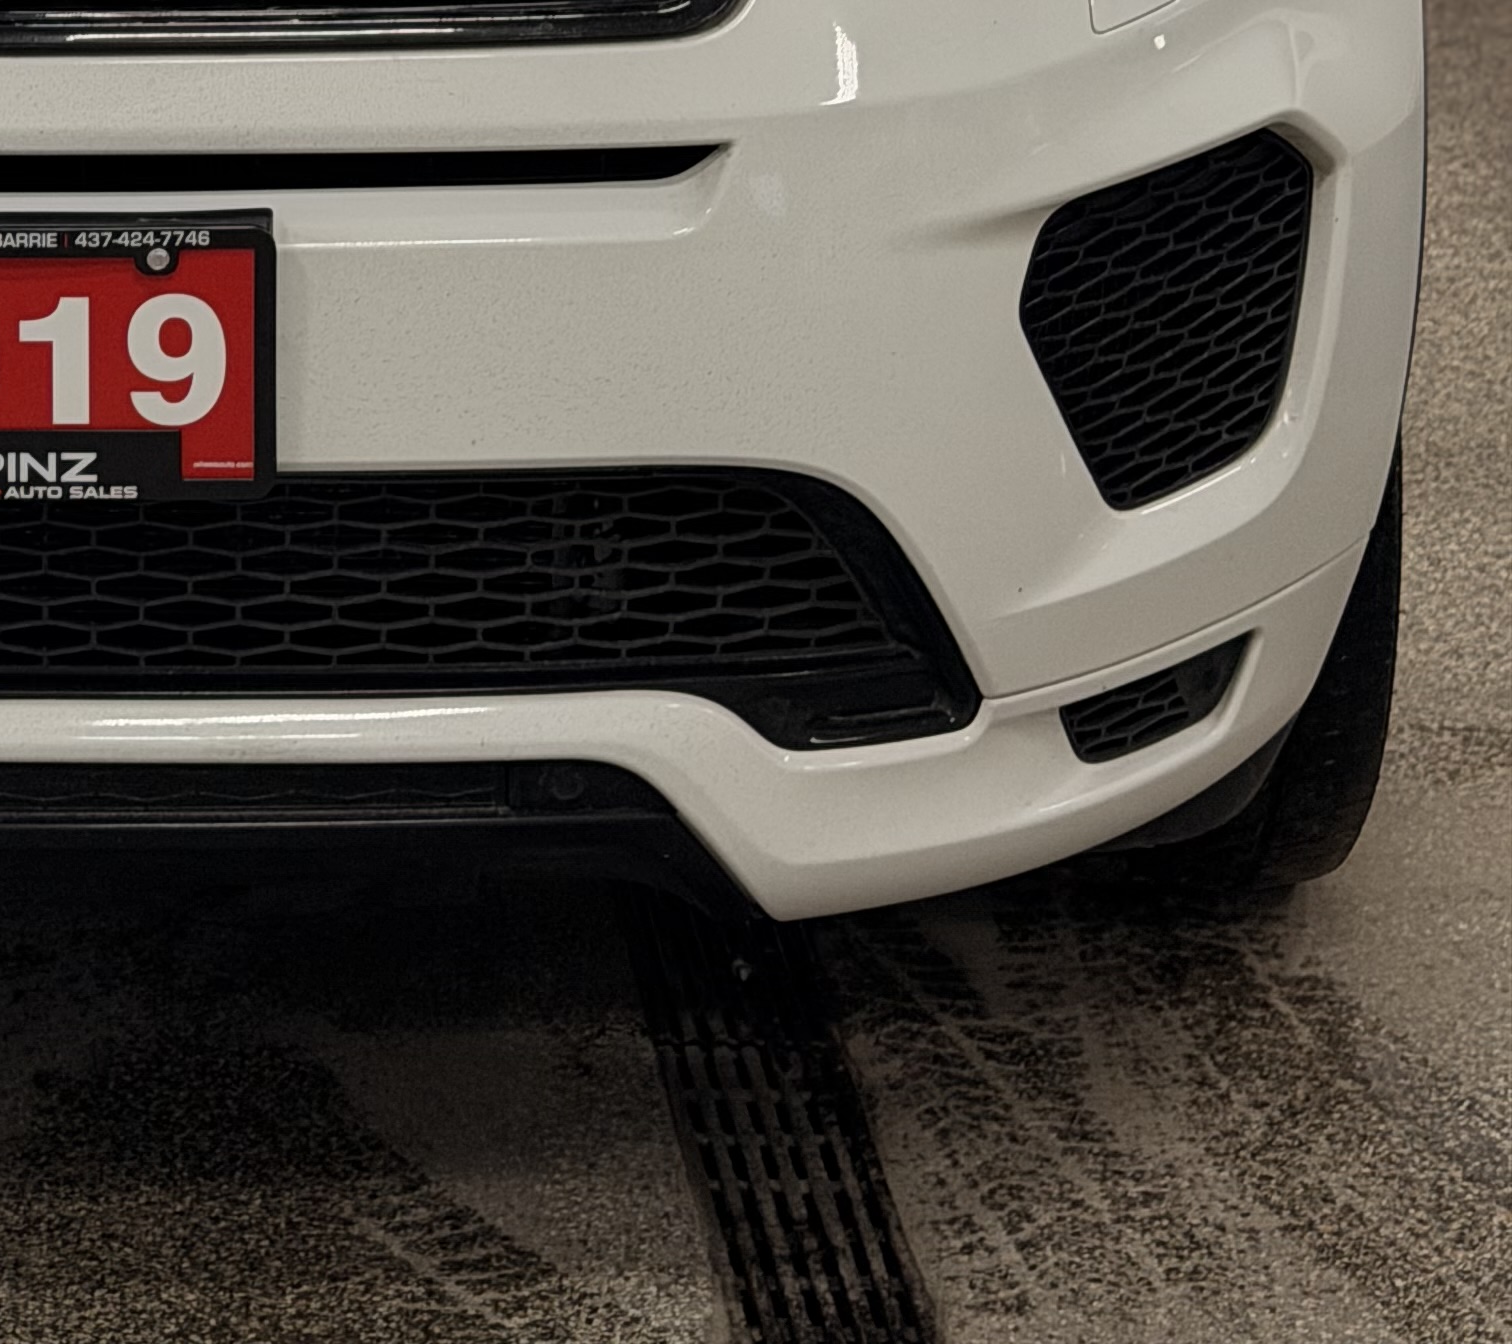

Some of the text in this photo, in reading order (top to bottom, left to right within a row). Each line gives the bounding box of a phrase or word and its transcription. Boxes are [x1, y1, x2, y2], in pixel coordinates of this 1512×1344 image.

[74, 230, 210, 248] 437-424-7746
[4, 485, 138, 500] AUTO SALES
